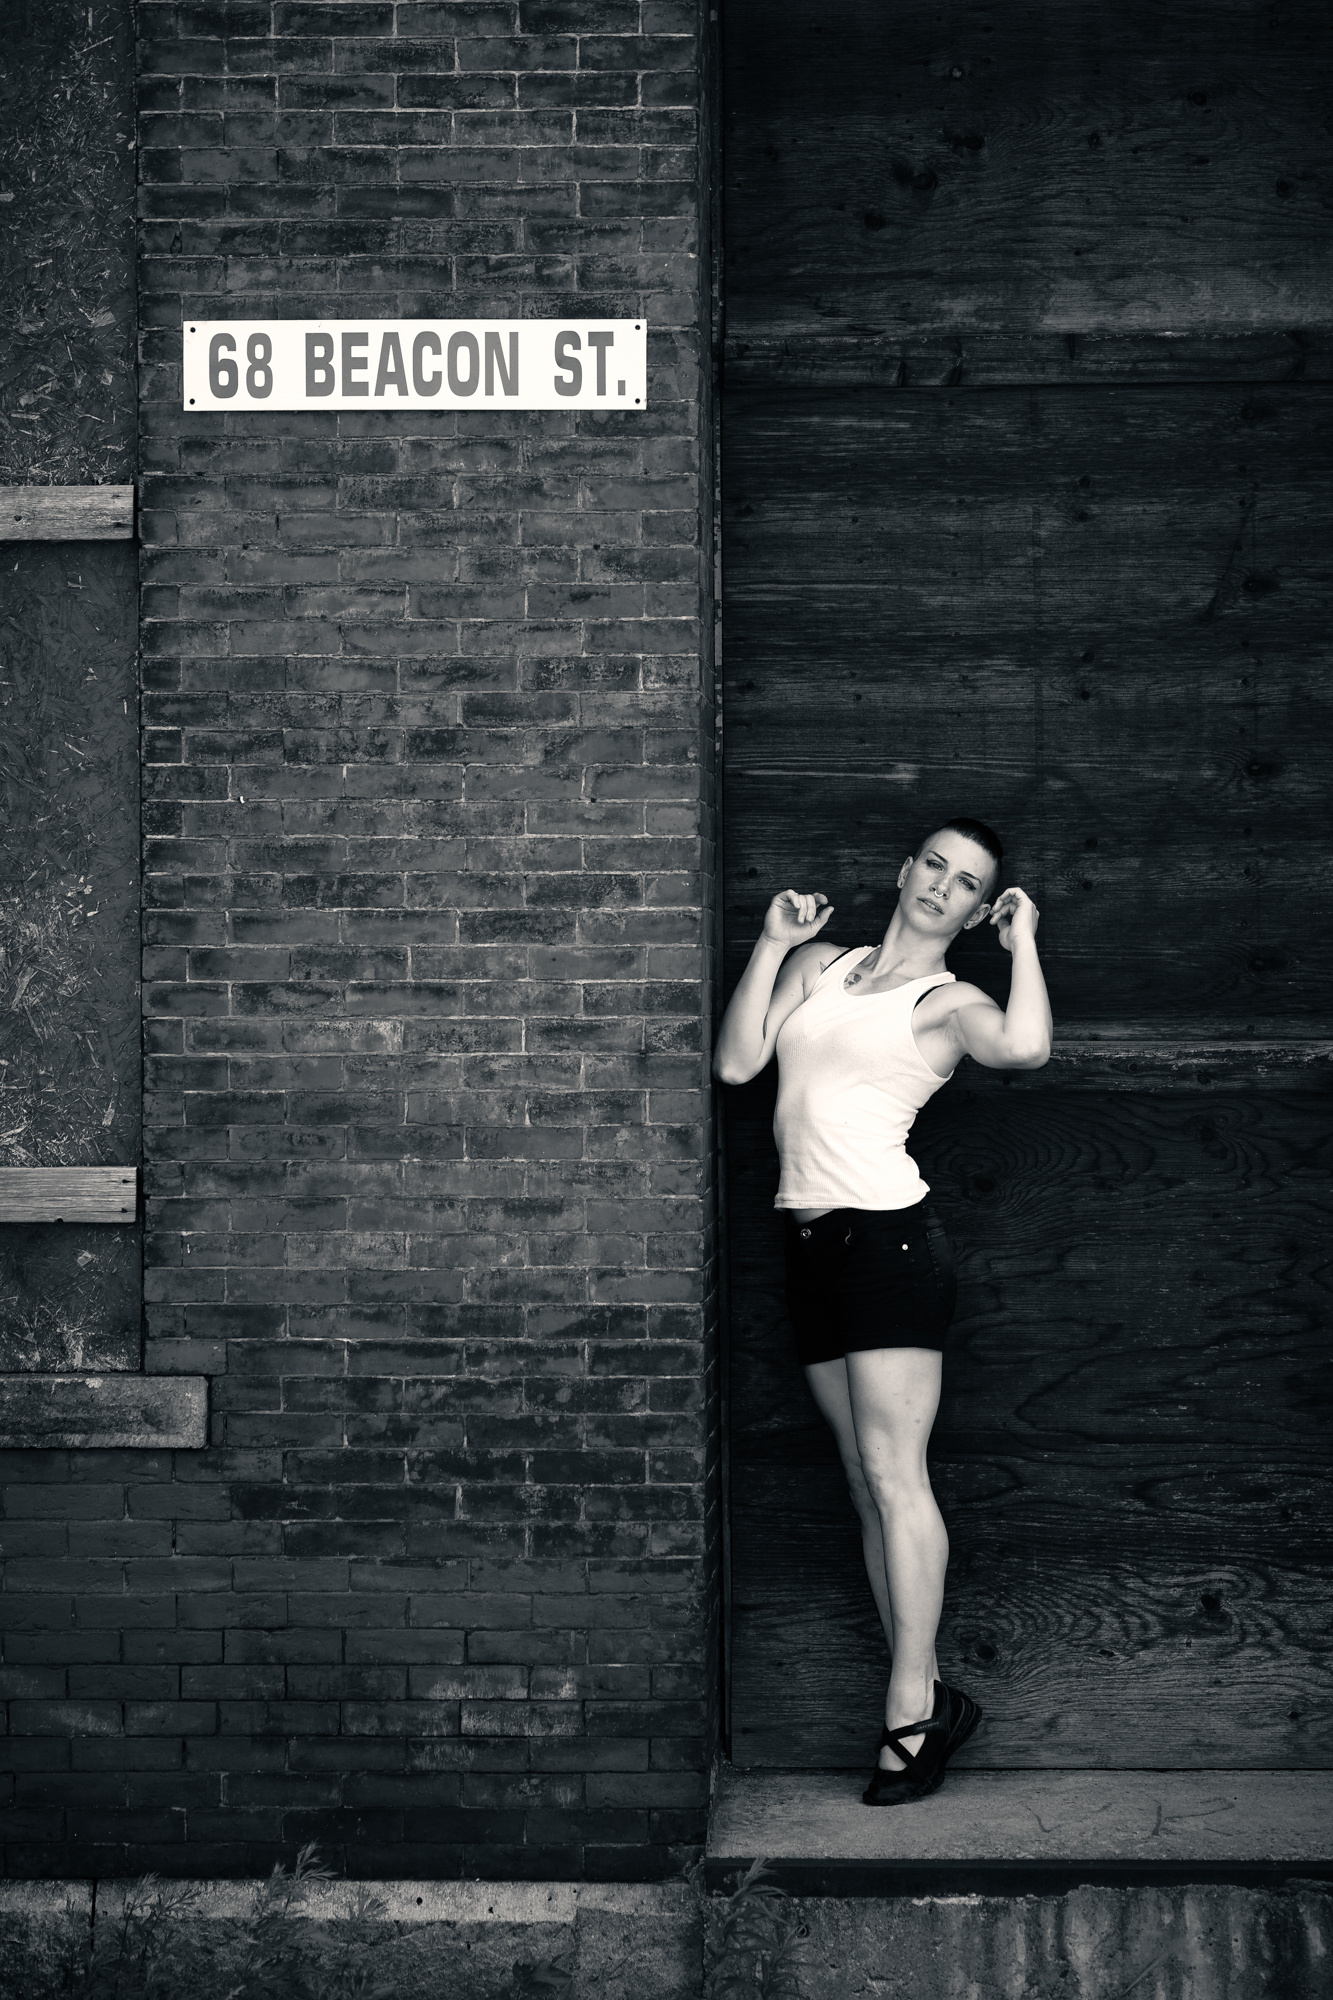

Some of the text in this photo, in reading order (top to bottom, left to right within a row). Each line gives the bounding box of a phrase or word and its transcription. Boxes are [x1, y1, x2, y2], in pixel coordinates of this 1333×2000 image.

[207, 330, 626, 399] 68 BEACON ST.
